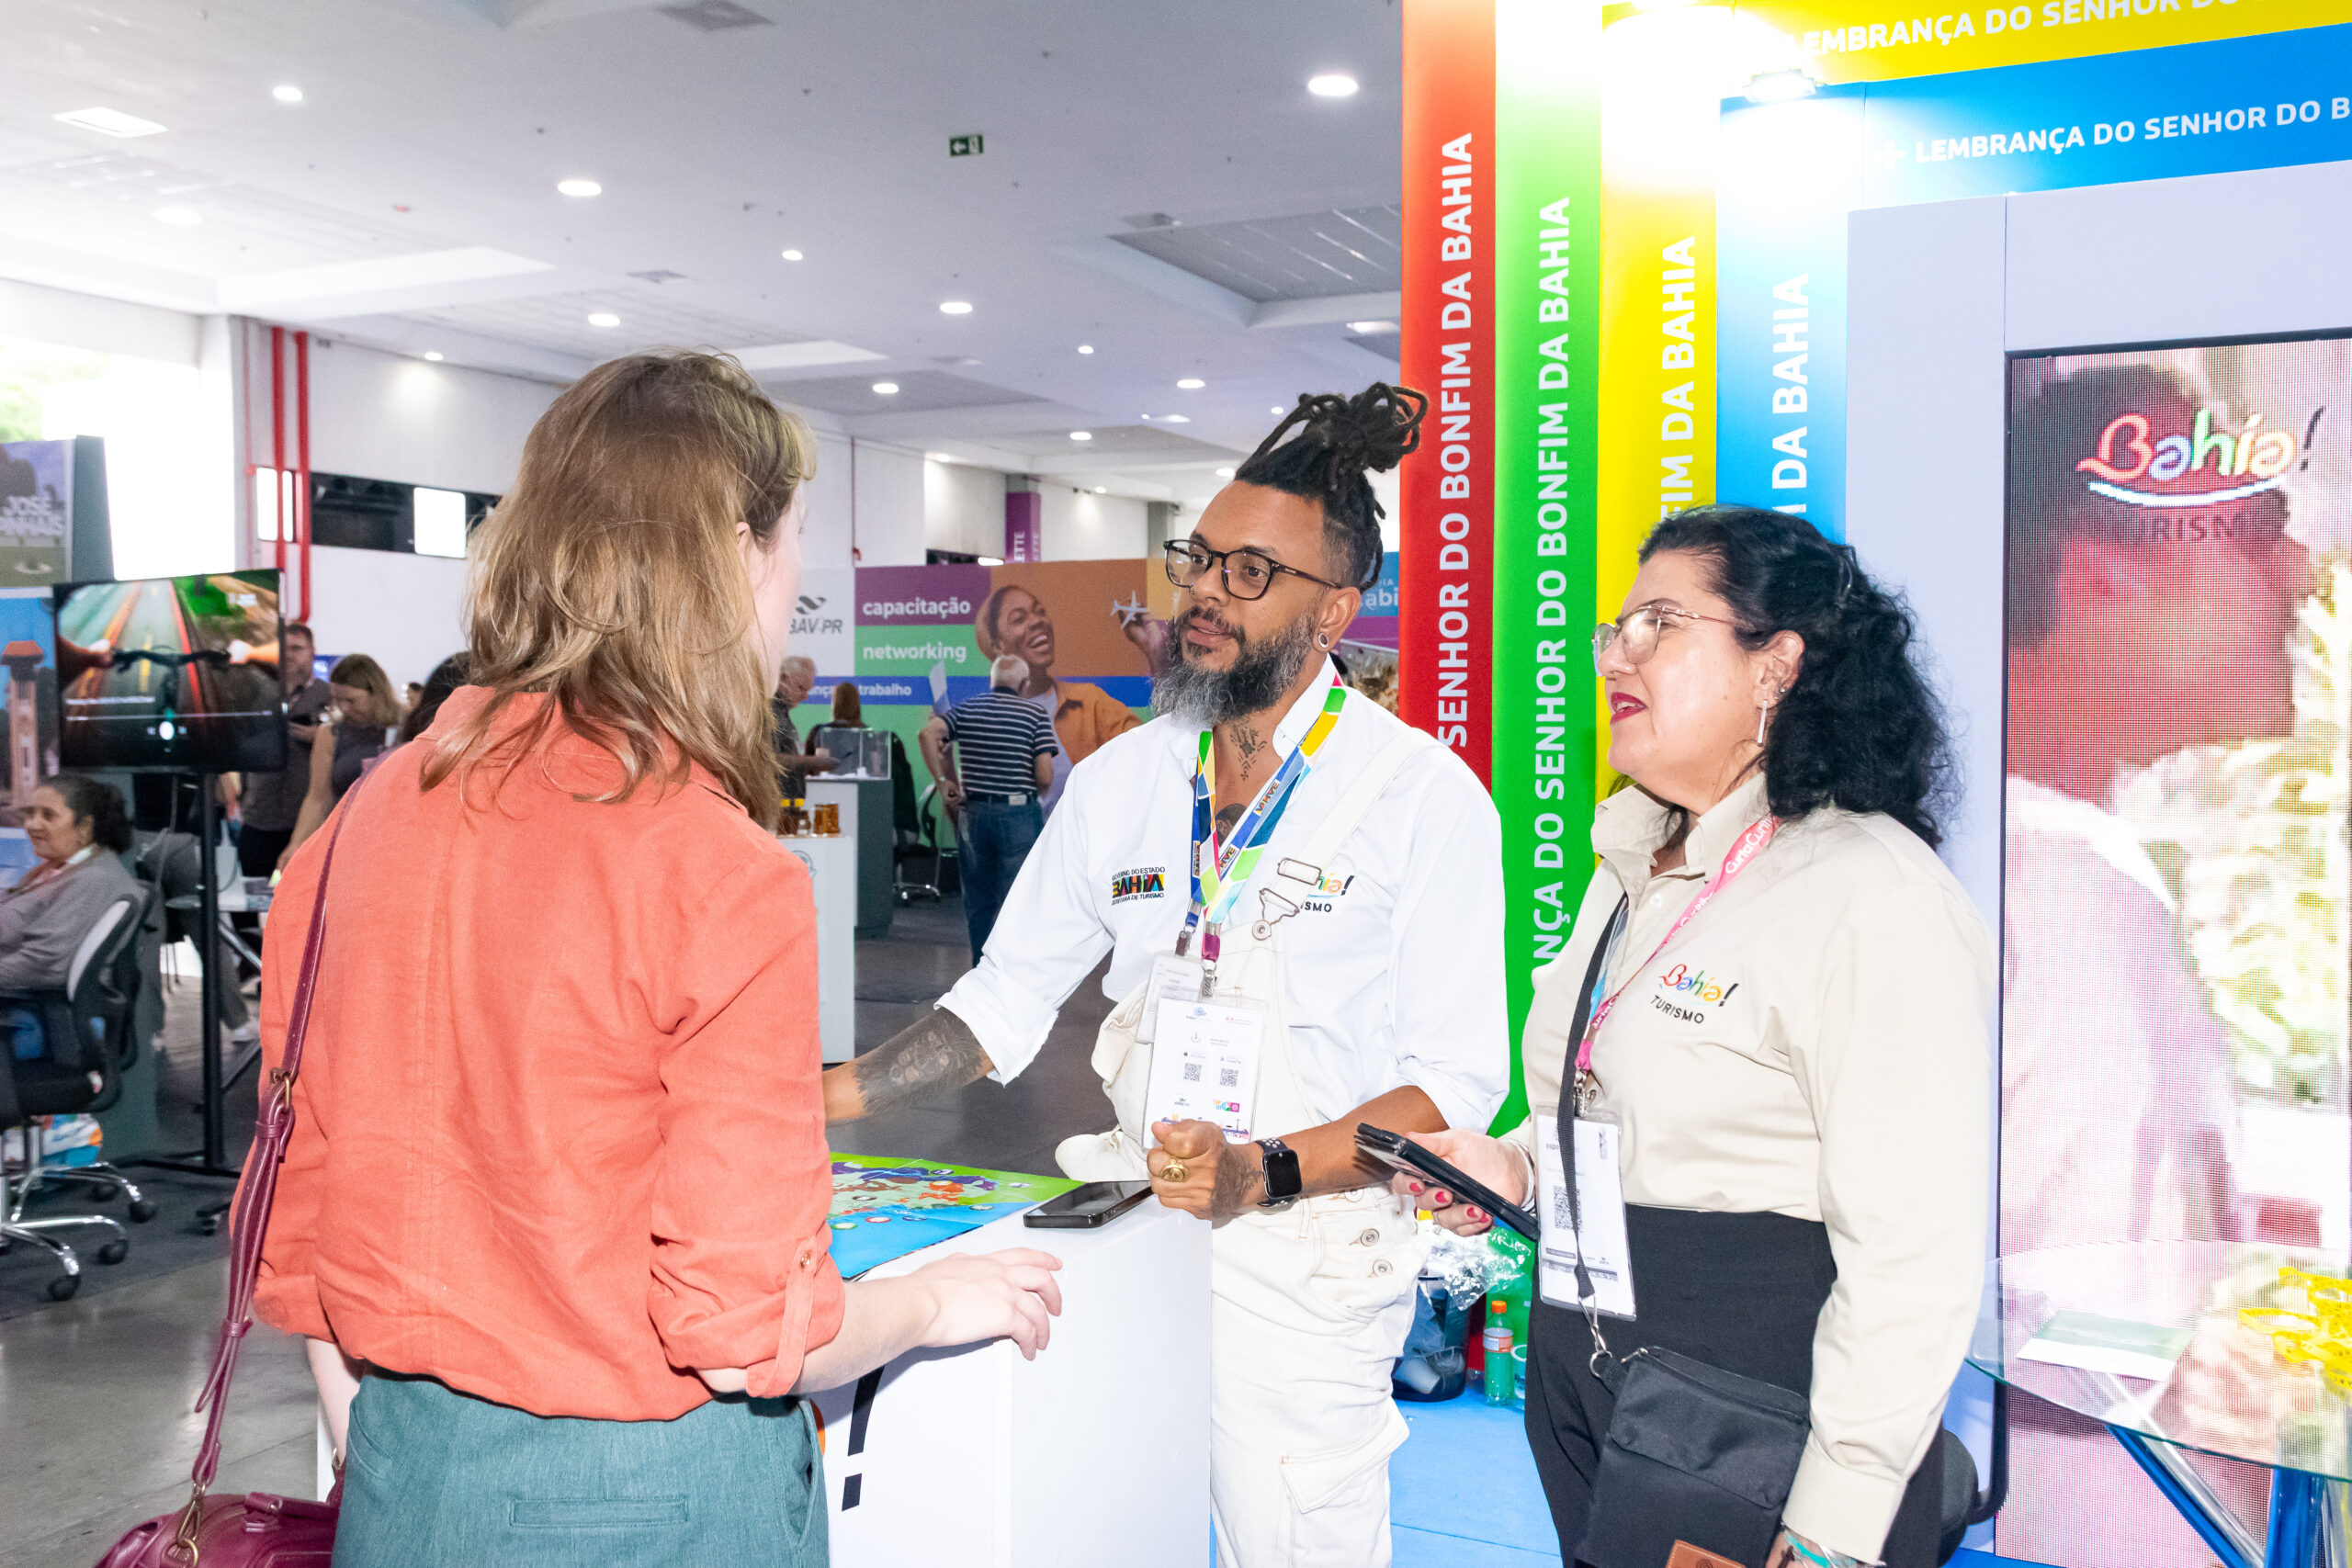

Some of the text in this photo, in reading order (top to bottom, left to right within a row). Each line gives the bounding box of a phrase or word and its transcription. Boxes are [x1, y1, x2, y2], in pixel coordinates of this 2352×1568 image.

[1985, 6, 2032, 34] DO
[2042, 0, 2180, 27] SENHOR
[1916, 126, 2086, 164] LEMBRANÇA
[2094, 120, 2135, 146] DO
[2144, 107, 2267, 140] SENHOR
[2277, 100, 2321, 126] DO
[1539, 196, 1570, 323] BAHIA
[1662, 235, 1695, 370] BAHIA
[1538, 333, 1569, 390] DA
[1772, 273, 1809, 414] BAHIA
[1438, 132, 1472, 748] SENHOR DO BONFIM DA BAHIA
[1661, 380, 1694, 441] DA
[1537, 401, 1568, 557] BONFIM
[1772, 425, 1808, 490] DA
[862, 596, 972, 620] capacitação
[1536, 570, 1566, 626] DO
[863, 642, 967, 663] networking
[858, 682, 912, 696] trabalho
[1534, 637, 1566, 801] SENHOR
[1533, 812, 1564, 869] DO
[1650, 995, 1705, 1024] TURISMO
